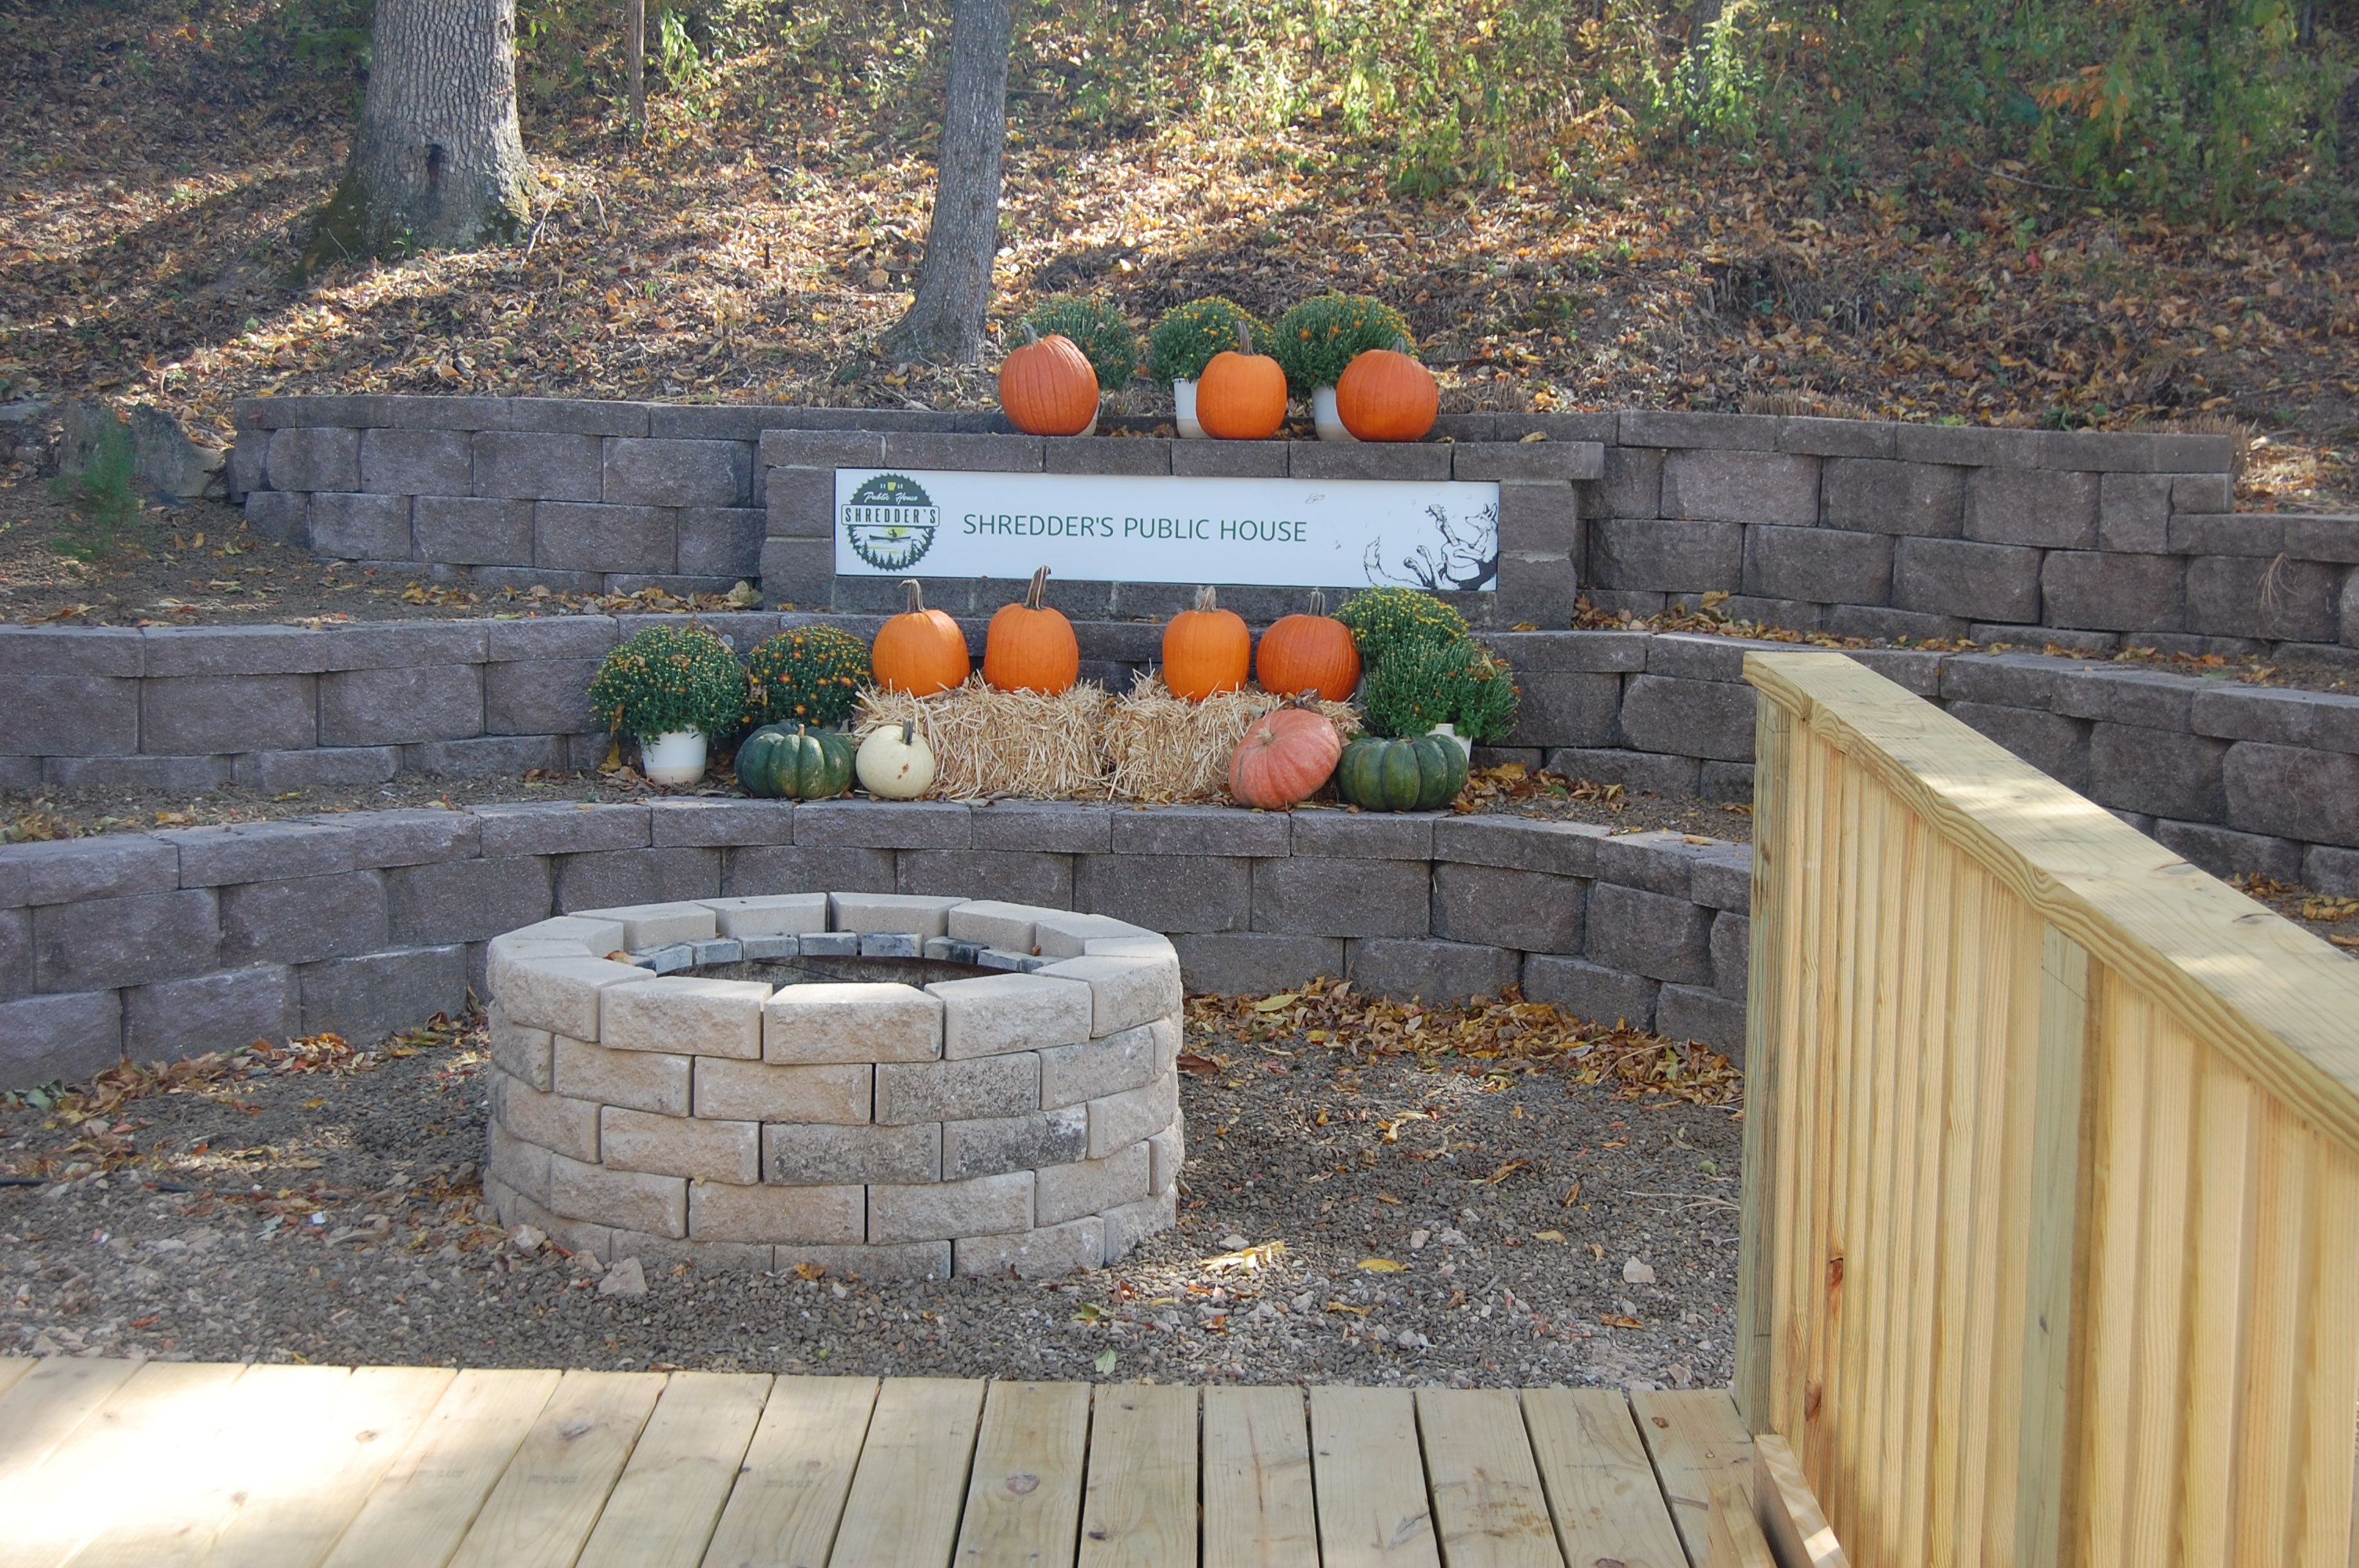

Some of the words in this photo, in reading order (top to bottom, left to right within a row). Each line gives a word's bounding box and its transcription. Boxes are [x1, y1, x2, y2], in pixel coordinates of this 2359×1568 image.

[845, 507, 936, 524] SHREDDER'S
[963, 514, 1114, 538] SHREDDER'S
[1124, 517, 1210, 540] PUBLIC
[1220, 520, 1307, 543] HOUSE
